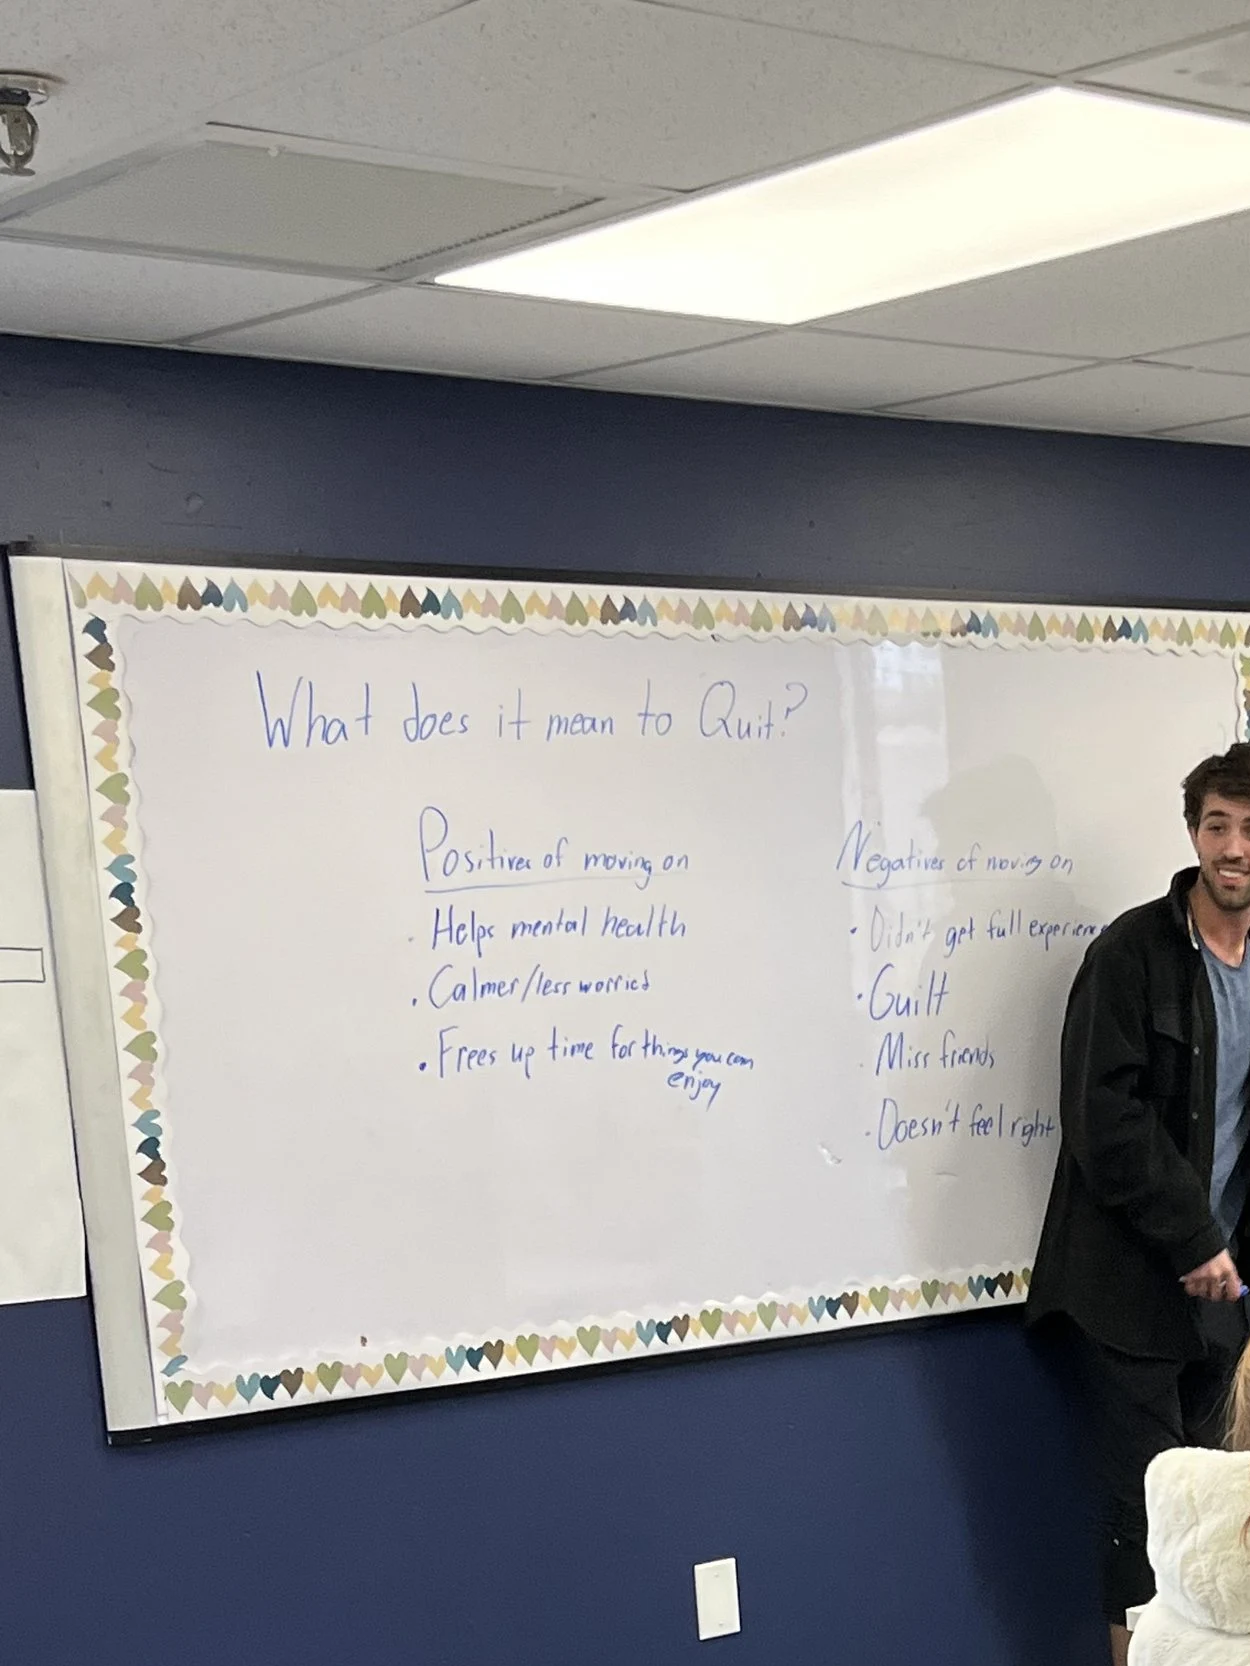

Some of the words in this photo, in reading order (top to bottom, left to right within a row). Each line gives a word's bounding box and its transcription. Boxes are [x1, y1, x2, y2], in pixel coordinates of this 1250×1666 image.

[256, 670, 372, 748] What
[403, 682, 469, 742] does
[499, 688, 530, 740] it
[546, 713, 614, 740] mean
[638, 679, 672, 736] to
[700, 680, 808, 740] Quit?
[420, 806, 531, 882] Positives
[544, 837, 567, 868] of
[584, 853, 653, 890] moving
[663, 854, 688, 871] on
[836, 820, 945, 887] Negatives
[957, 843, 981, 871] of
[1050, 855, 1073, 874] on
[432, 904, 494, 958] Helps
[511, 906, 587, 940] mental
[601, 904, 686, 938] health
[871, 905, 930, 952] Didn't
[944, 917, 975, 958] get
[987, 909, 1021, 940] full
[429, 964, 571, 1009] Calmer/less
[577, 969, 650, 993] worried
[869, 963, 949, 1020] Guilt
[439, 1026, 496, 1078] Frees
[512, 1045, 535, 1080] up
[548, 1026, 593, 1061] time
[610, 1022, 638, 1060] for
[641, 1027, 690, 1065] things
[691, 1047, 723, 1071] you
[725, 1050, 755, 1071] can
[876, 1032, 930, 1076] Miss
[940, 1029, 994, 1069] friends
[666, 1069, 722, 1113] enjoy
[878, 1098, 960, 1151] Doesn't
[969, 1103, 1003, 1138] feel
[1011, 1109, 1053, 1147] right
